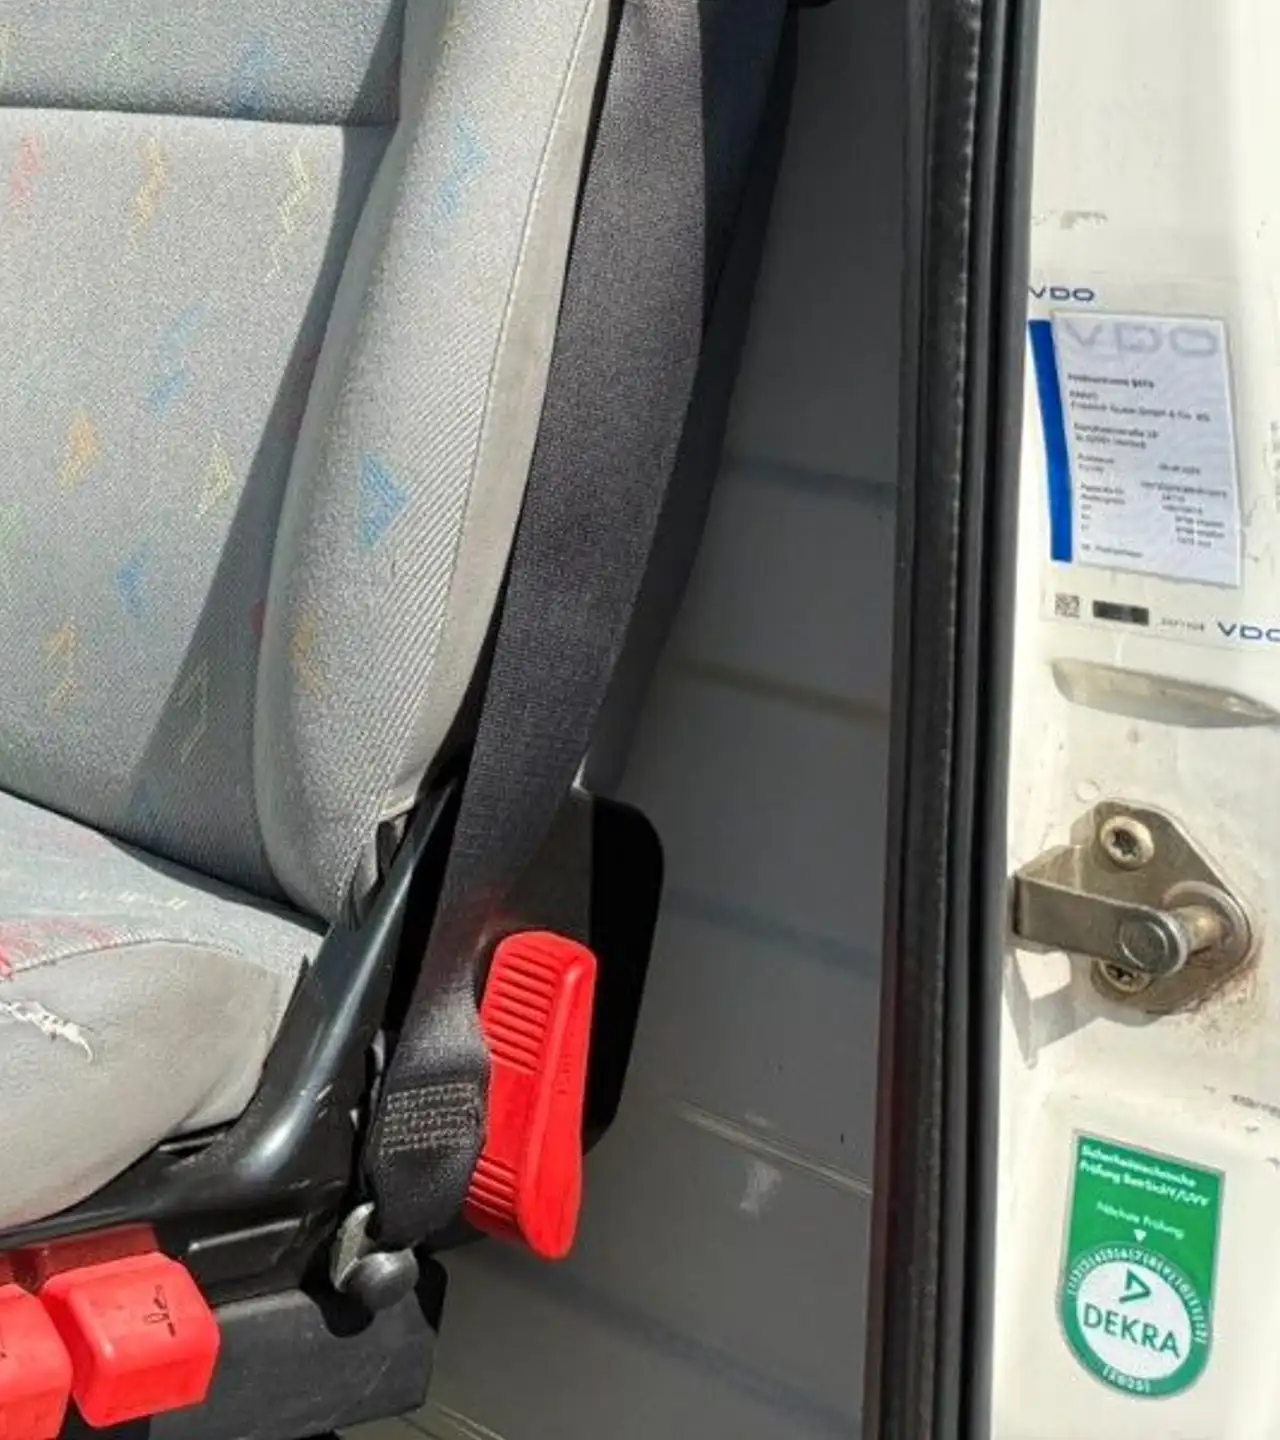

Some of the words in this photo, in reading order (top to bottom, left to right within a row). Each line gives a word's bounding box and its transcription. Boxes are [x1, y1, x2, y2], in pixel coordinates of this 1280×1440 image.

[1028, 286, 1096, 302] VDO
[1063, 318, 1220, 357] VDO
[1083, 1303, 1181, 1359] DEKRA
